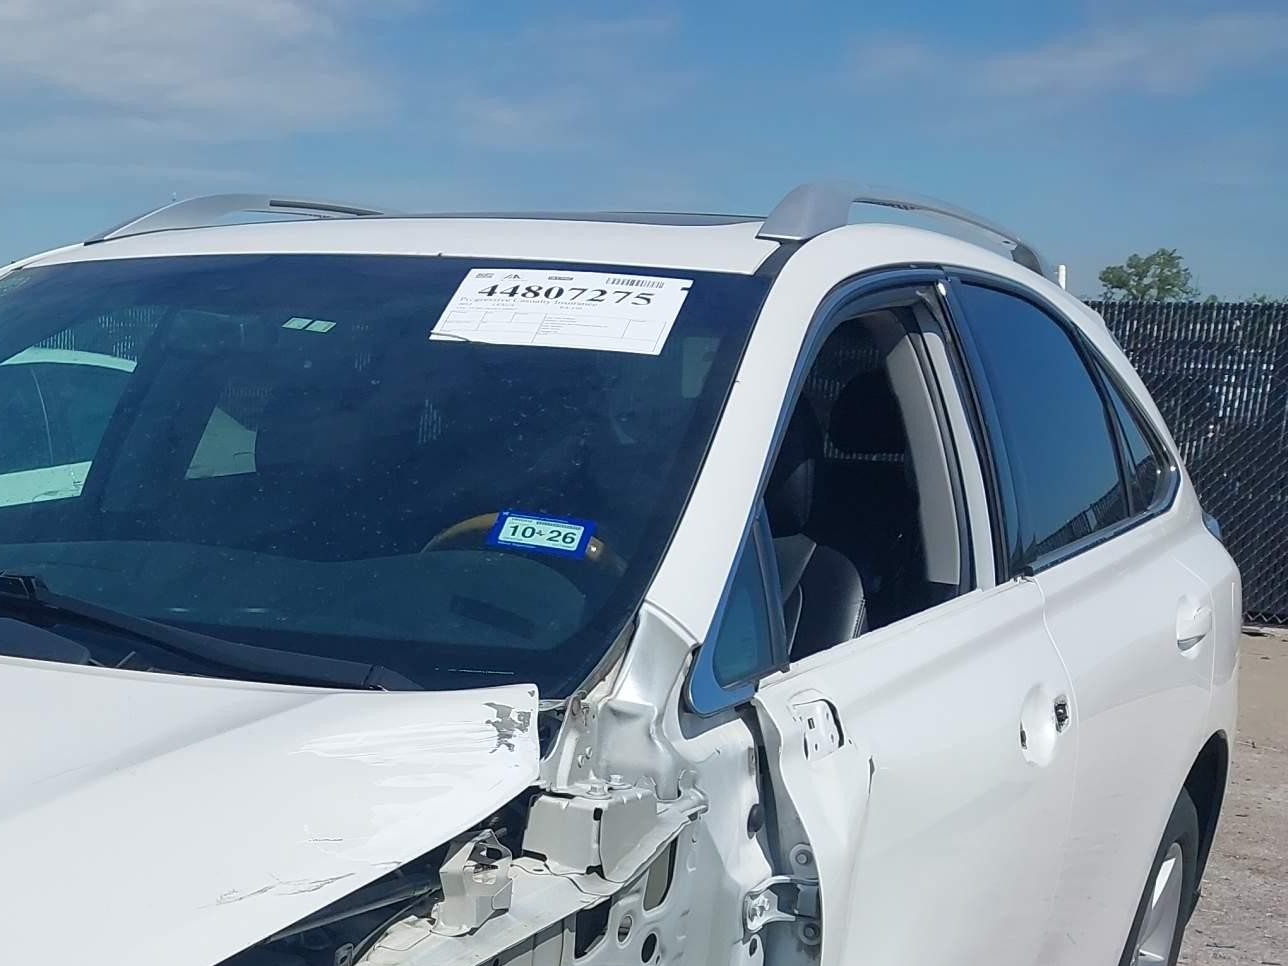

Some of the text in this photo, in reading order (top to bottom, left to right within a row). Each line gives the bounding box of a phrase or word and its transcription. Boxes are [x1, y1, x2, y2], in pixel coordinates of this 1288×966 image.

[478, 284, 655, 306] 44807275
[509, 525, 536, 539] 10
[546, 529, 577, 545] 26
